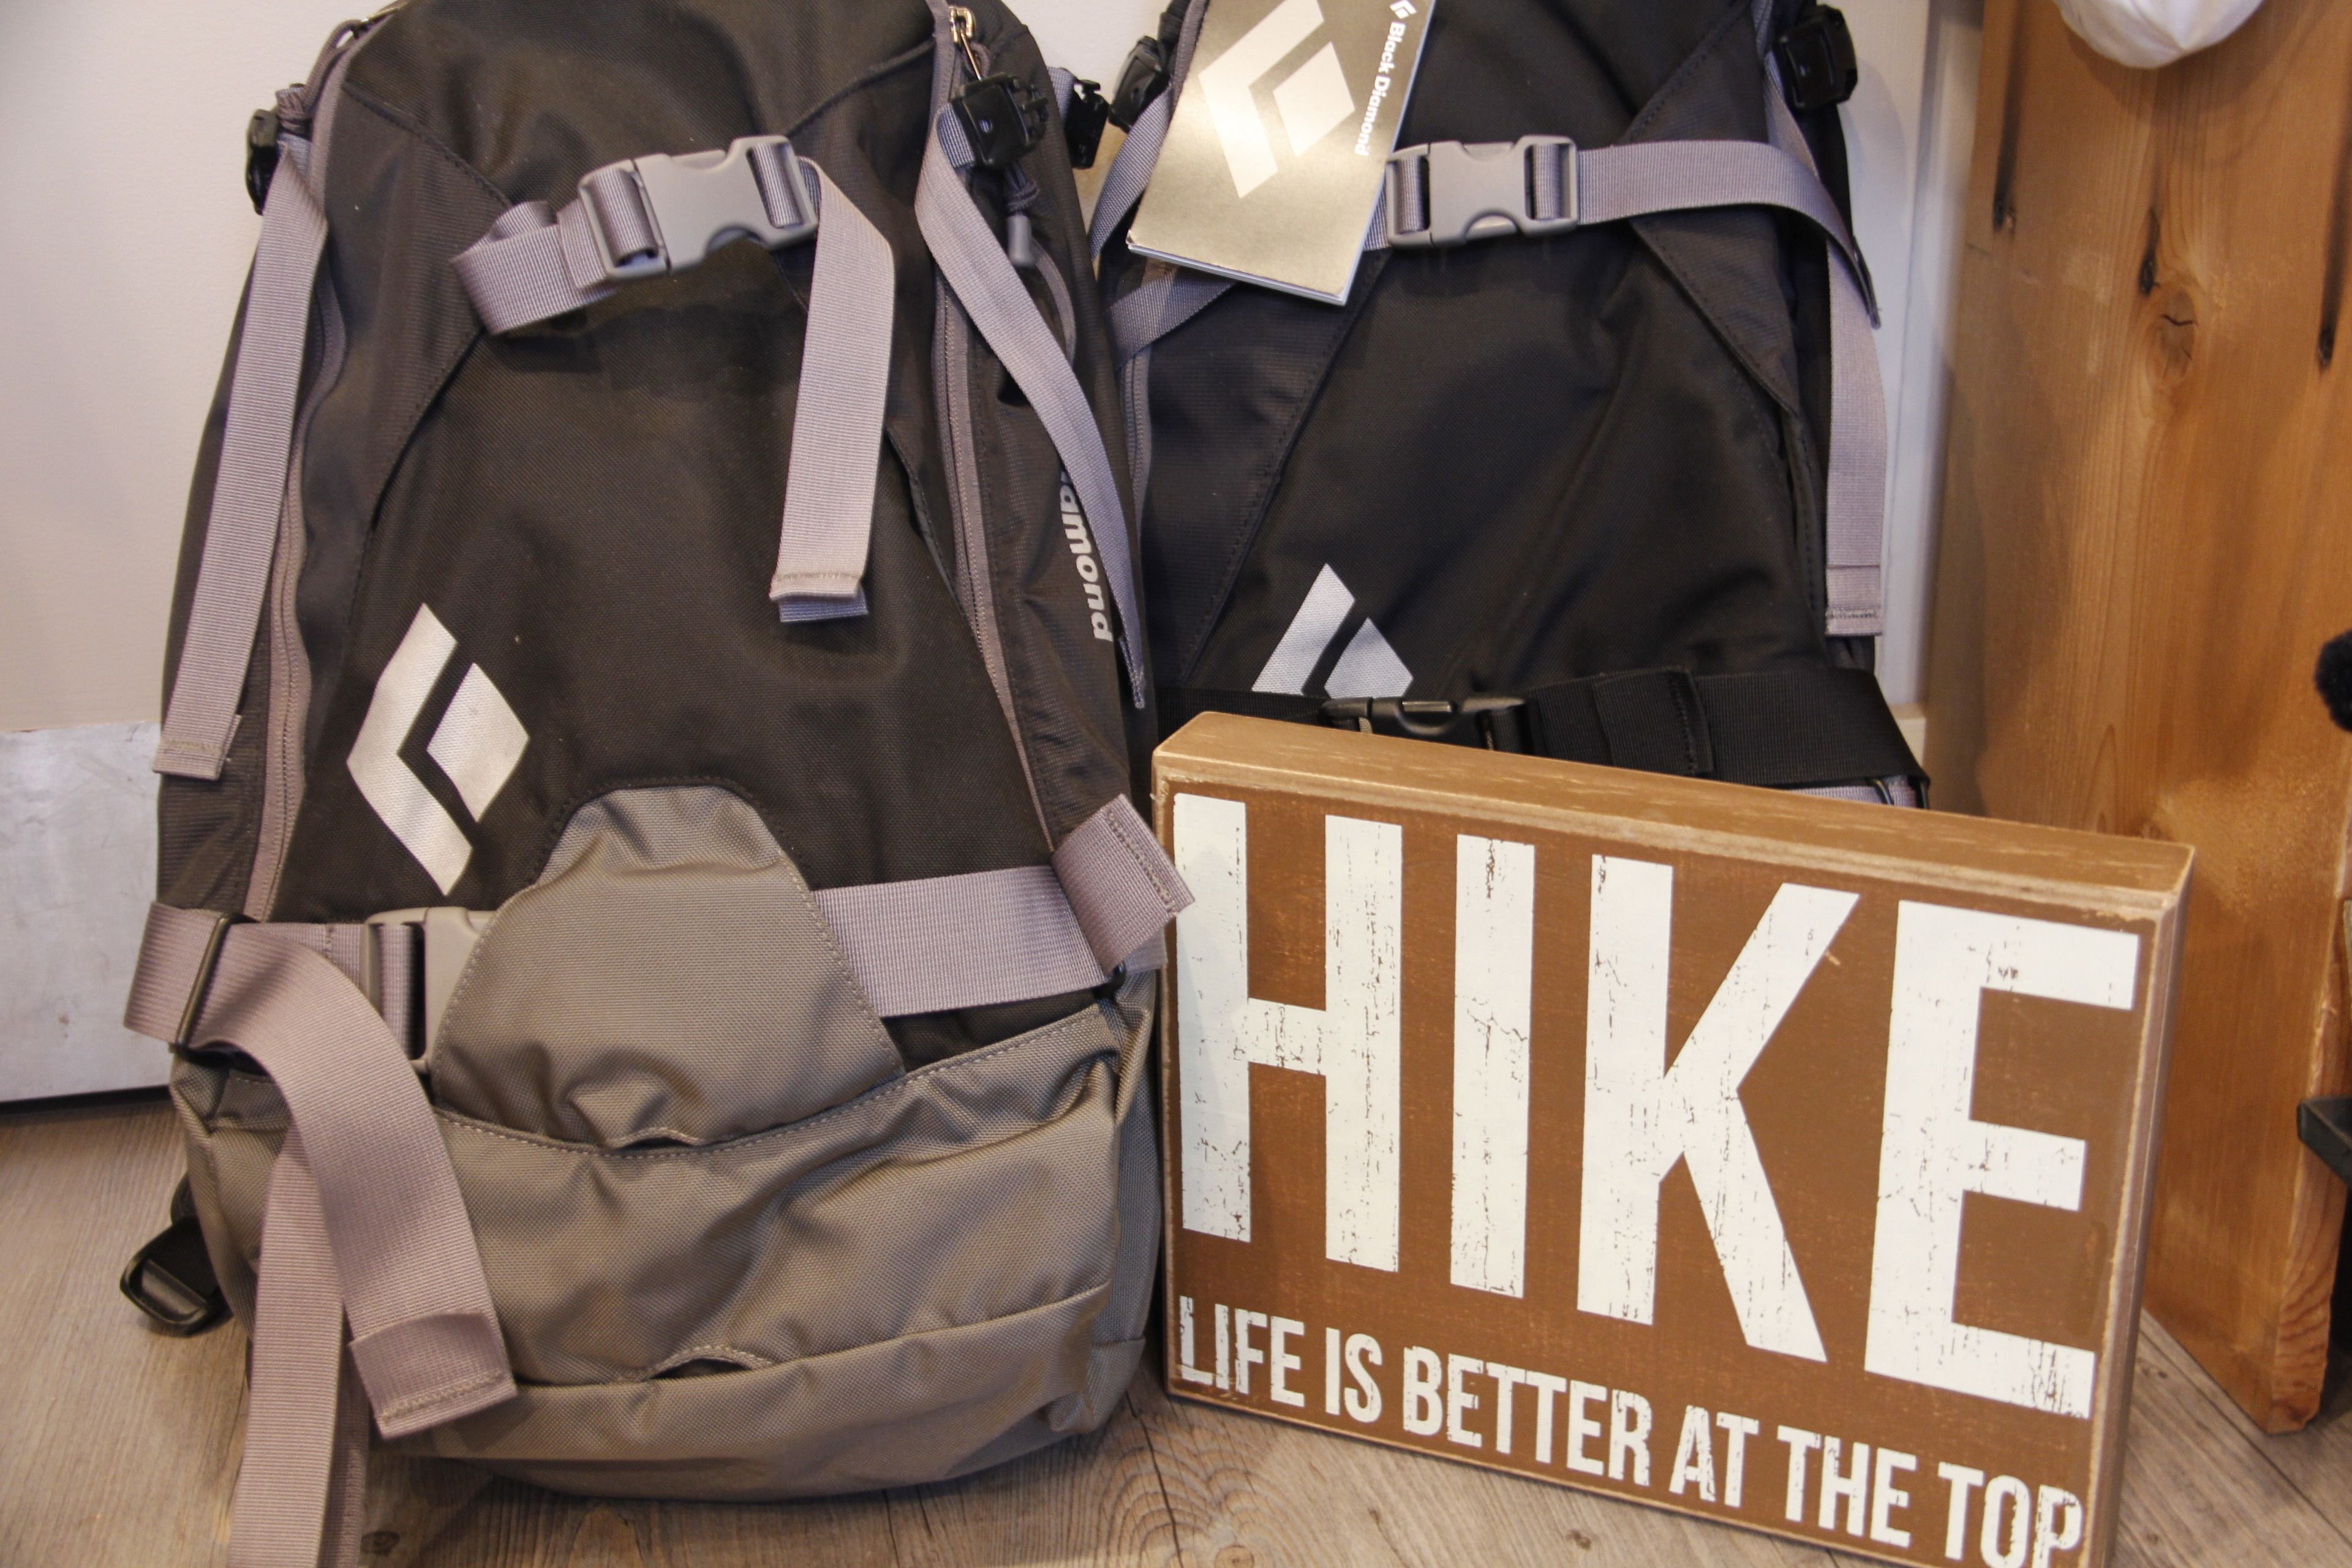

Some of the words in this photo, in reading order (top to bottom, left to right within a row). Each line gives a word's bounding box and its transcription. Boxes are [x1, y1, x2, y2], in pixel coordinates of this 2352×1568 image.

[1354, 75, 1391, 156] Diamond
[1378, 21, 1406, 74] Black
[1060, 470, 1114, 642] amond
[1173, 793, 2139, 1420] HIKE
[1178, 1295, 1305, 1407] LIFE
[1325, 1327, 1382, 1423] IS
[1403, 1346, 1653, 1487] BETTER
[1669, 1404, 1759, 1509] AT
[1777, 1425, 1917, 1548] THE
[1938, 1461, 2082, 1568] TOP
